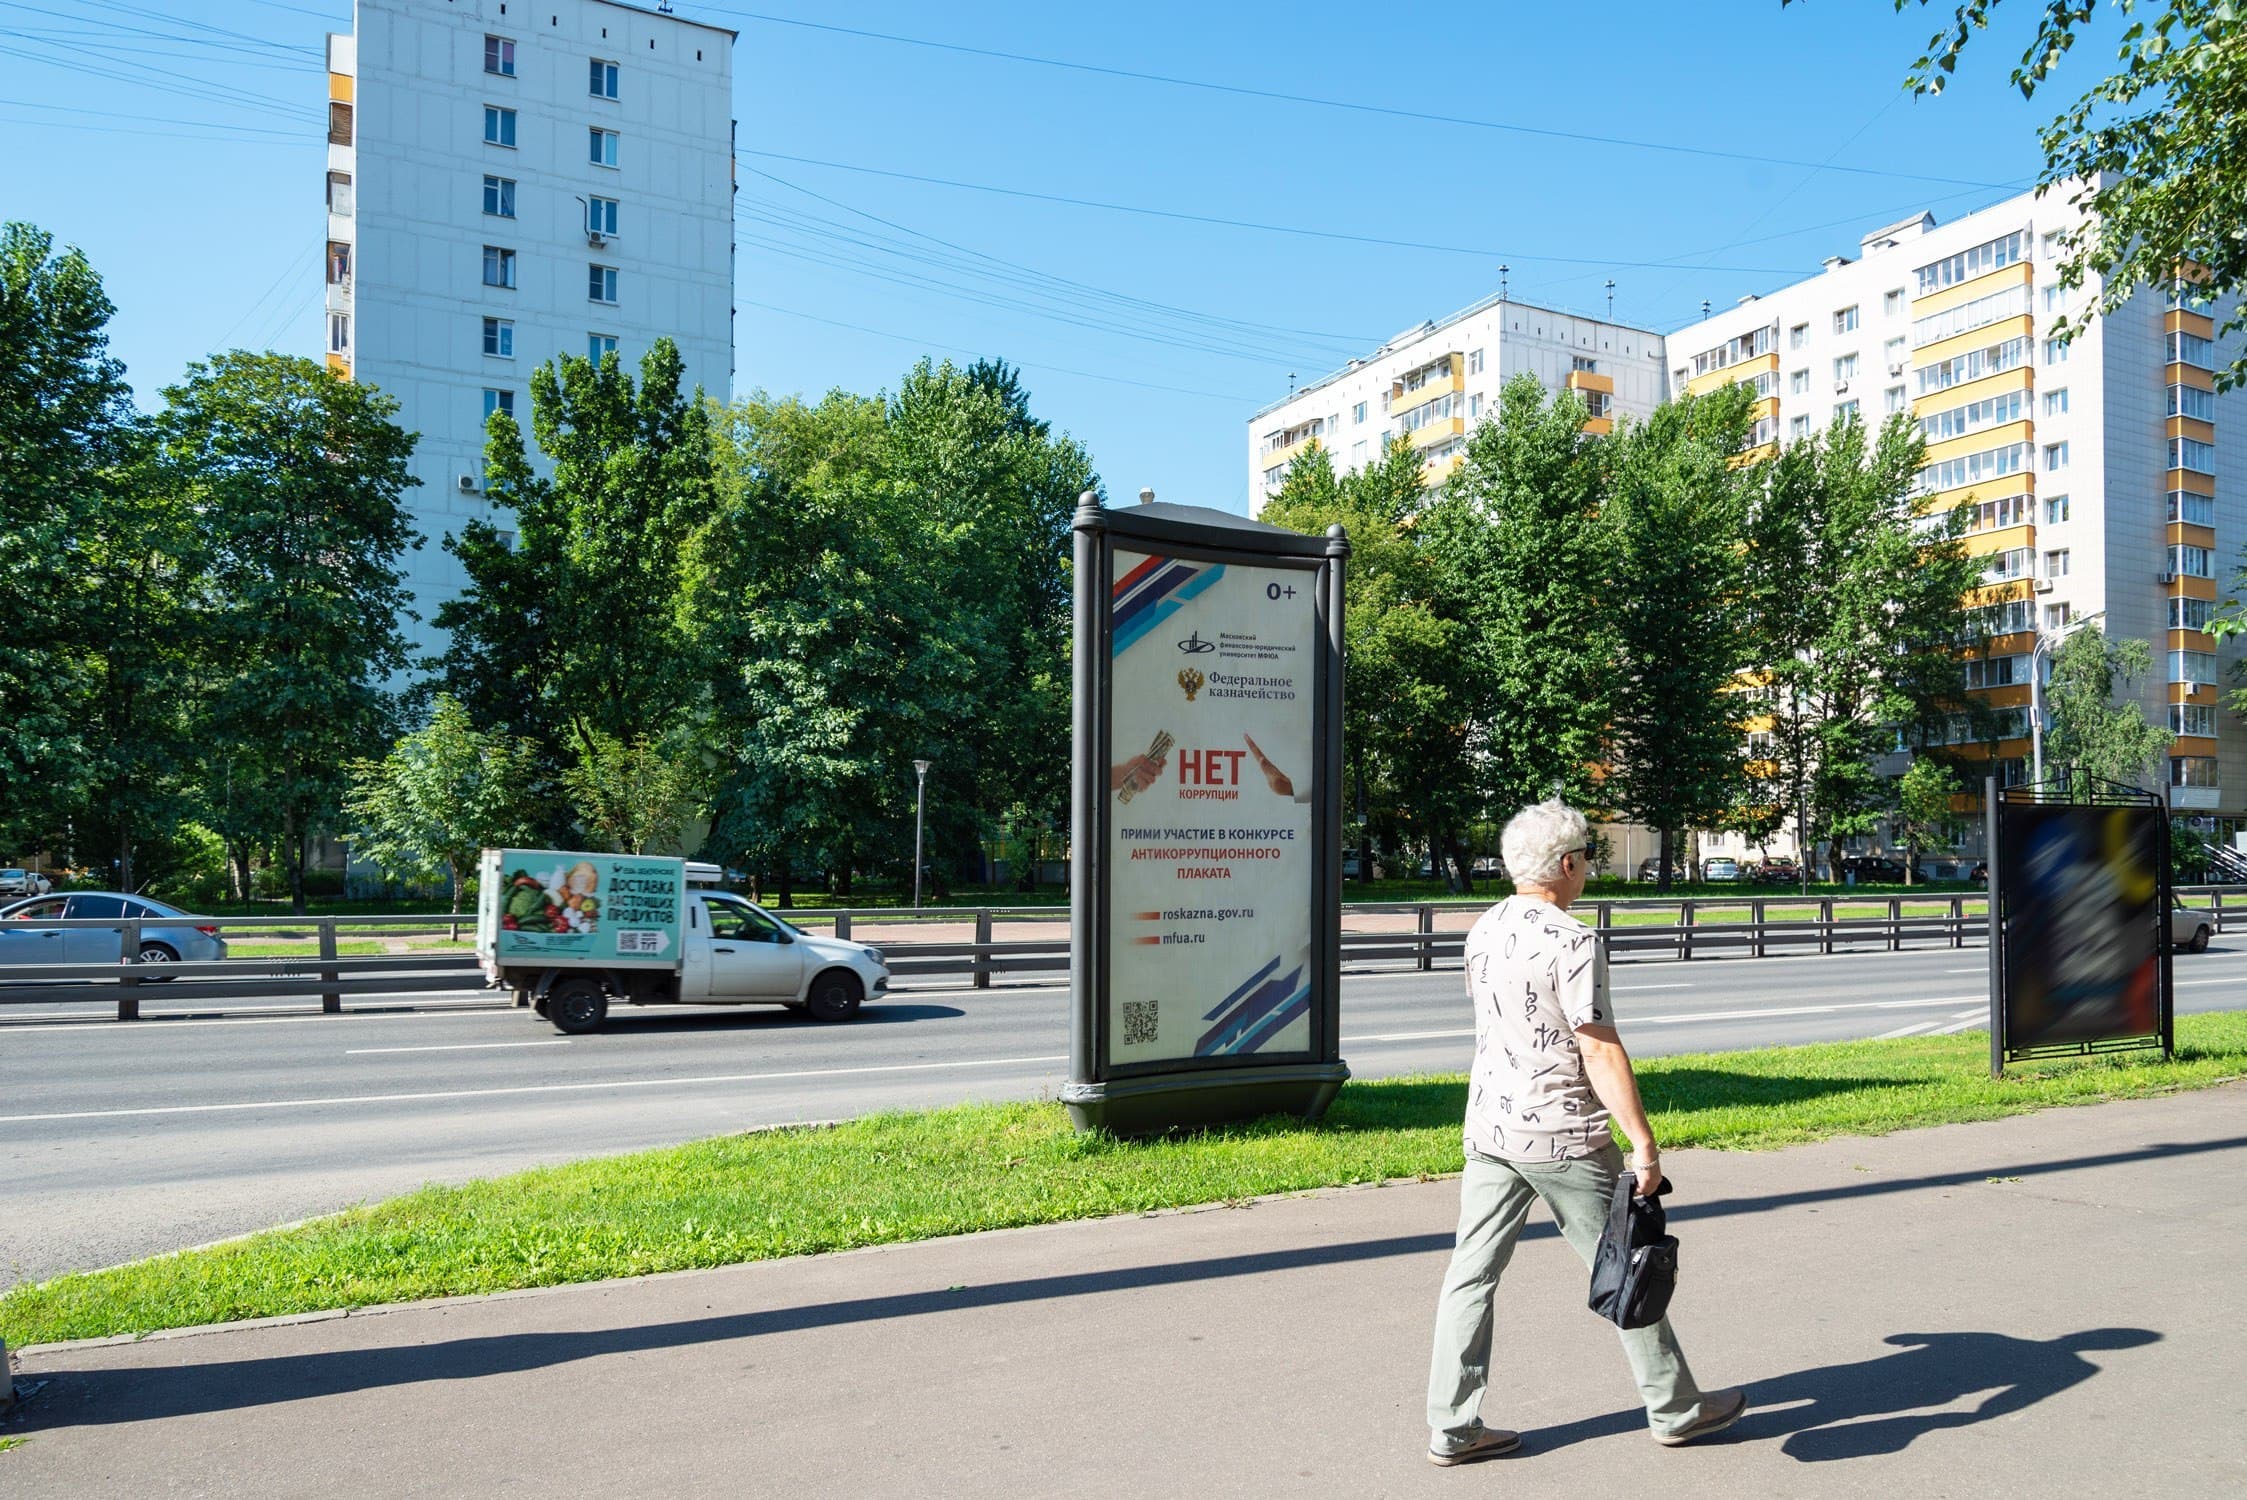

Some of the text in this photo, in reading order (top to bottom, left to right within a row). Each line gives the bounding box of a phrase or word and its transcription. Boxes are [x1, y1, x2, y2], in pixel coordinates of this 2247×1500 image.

[1266, 582, 1297, 601] 0+
[1220, 632, 1257, 641] Московский
[1209, 671, 1293, 688] Федеральное
[1209, 687, 1296, 700] казначейство
[1179, 749, 1246, 785] НЕТ
[1179, 789, 1239, 801] КОРРУПЦИИ
[1121, 828, 1295, 840] ПРИМИ УЧАСТИЕ В КОНКУРСЕ
[1131, 848, 1281, 861] АНТИКОРРУПЦИОННОГО
[1177, 868, 1232, 879] ПЛАКАТА
[608, 877, 675, 894] ДОСТАВКА
[608, 908, 675, 924] ПРОДУКТОВ
[1163, 908, 1254, 921] roskazna.gov.ru
[1163, 932, 1205, 944] mfua.ru
